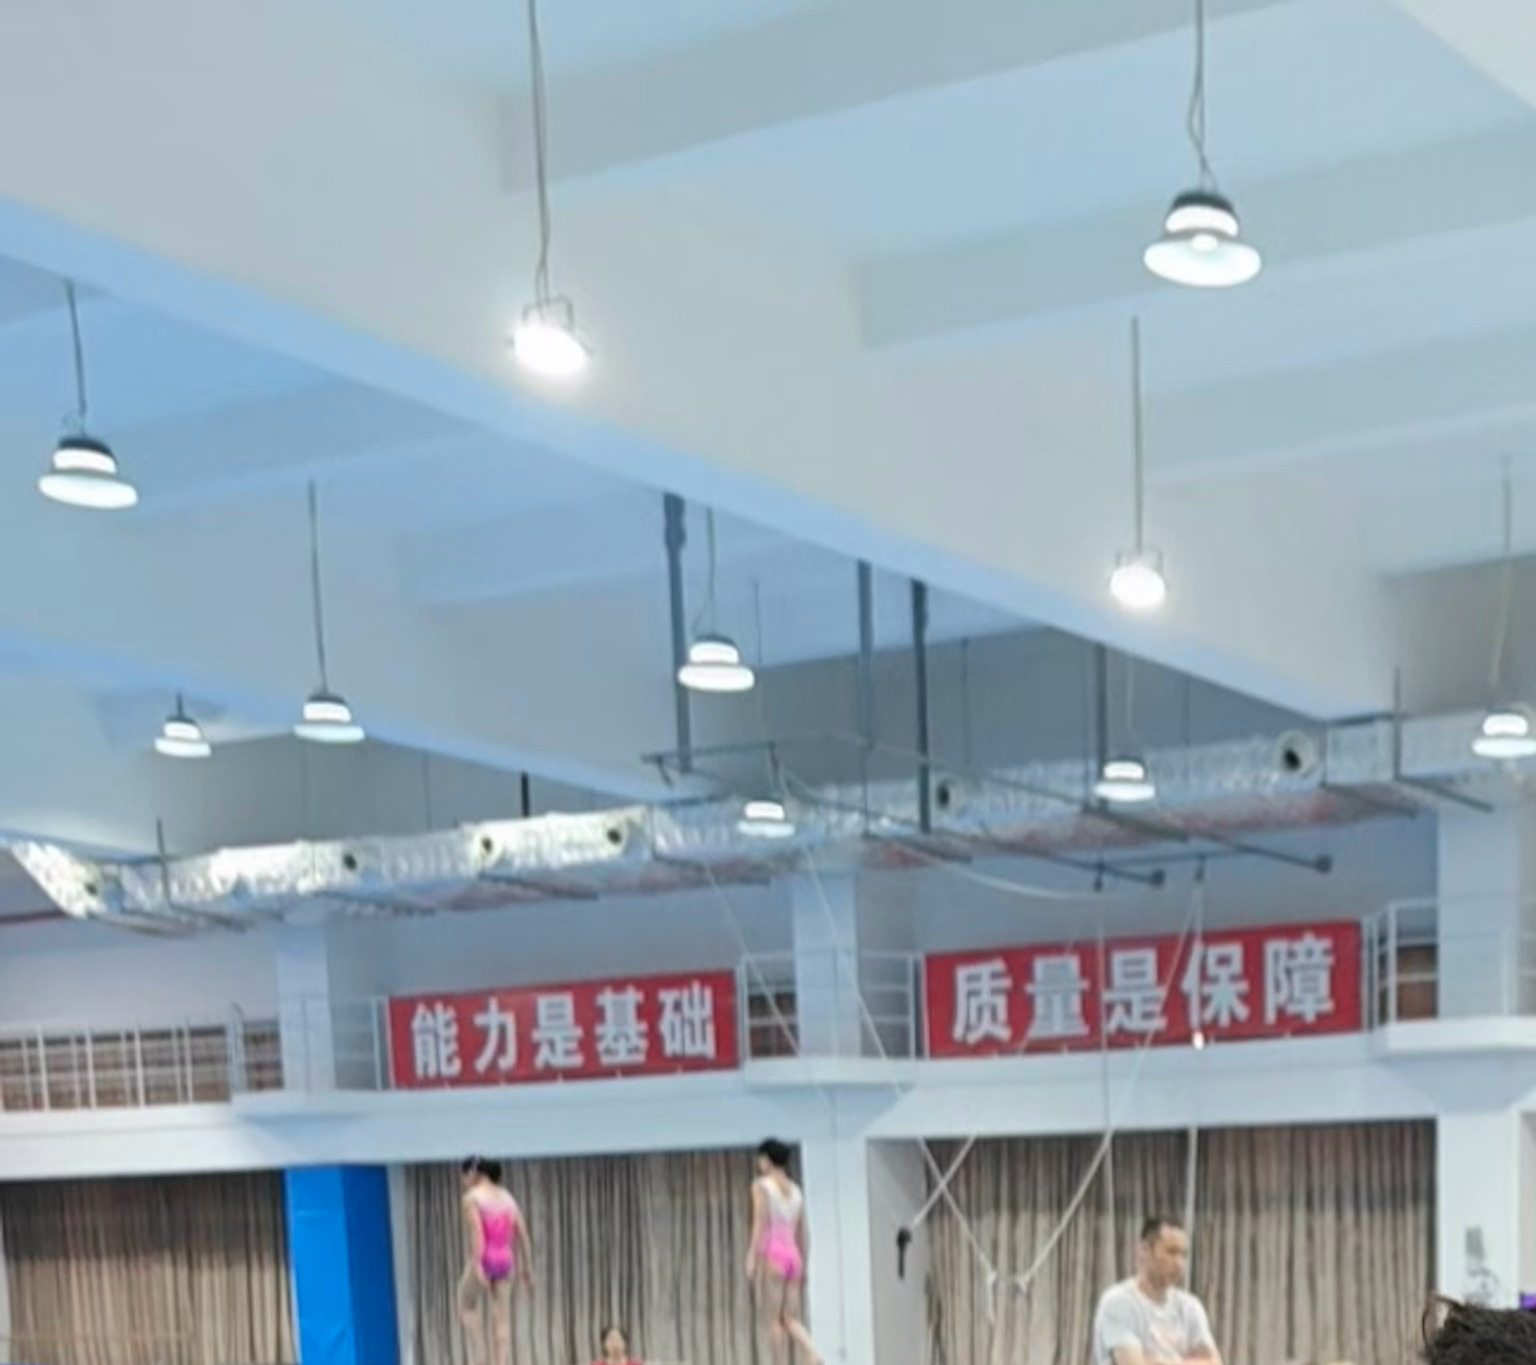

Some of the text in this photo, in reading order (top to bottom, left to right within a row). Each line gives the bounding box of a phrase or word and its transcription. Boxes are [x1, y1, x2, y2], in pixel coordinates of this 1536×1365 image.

[410, 980, 717, 1080] 能力是基础
[952, 931, 1337, 1045] 质量是保障
